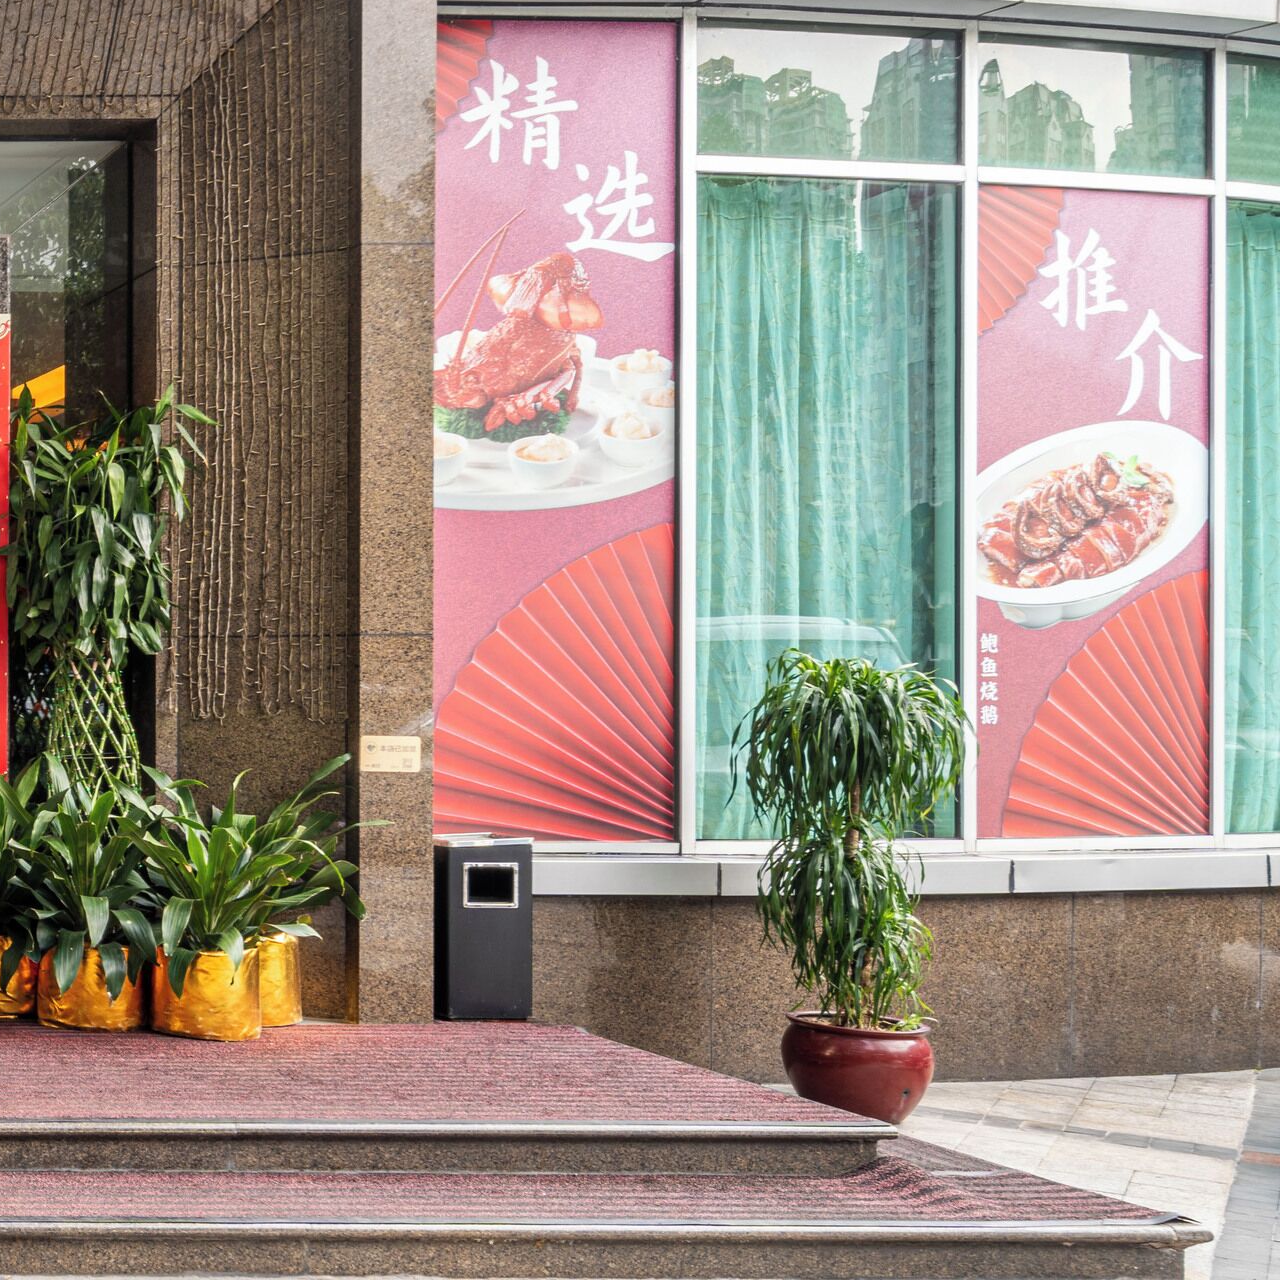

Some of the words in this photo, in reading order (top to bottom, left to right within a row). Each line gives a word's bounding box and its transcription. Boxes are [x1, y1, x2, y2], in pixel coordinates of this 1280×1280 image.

[460, 55, 677, 262] 精选
[1039, 227, 1206, 421] 推介
[980, 633, 998, 725] 鲍鱼烧鹅
